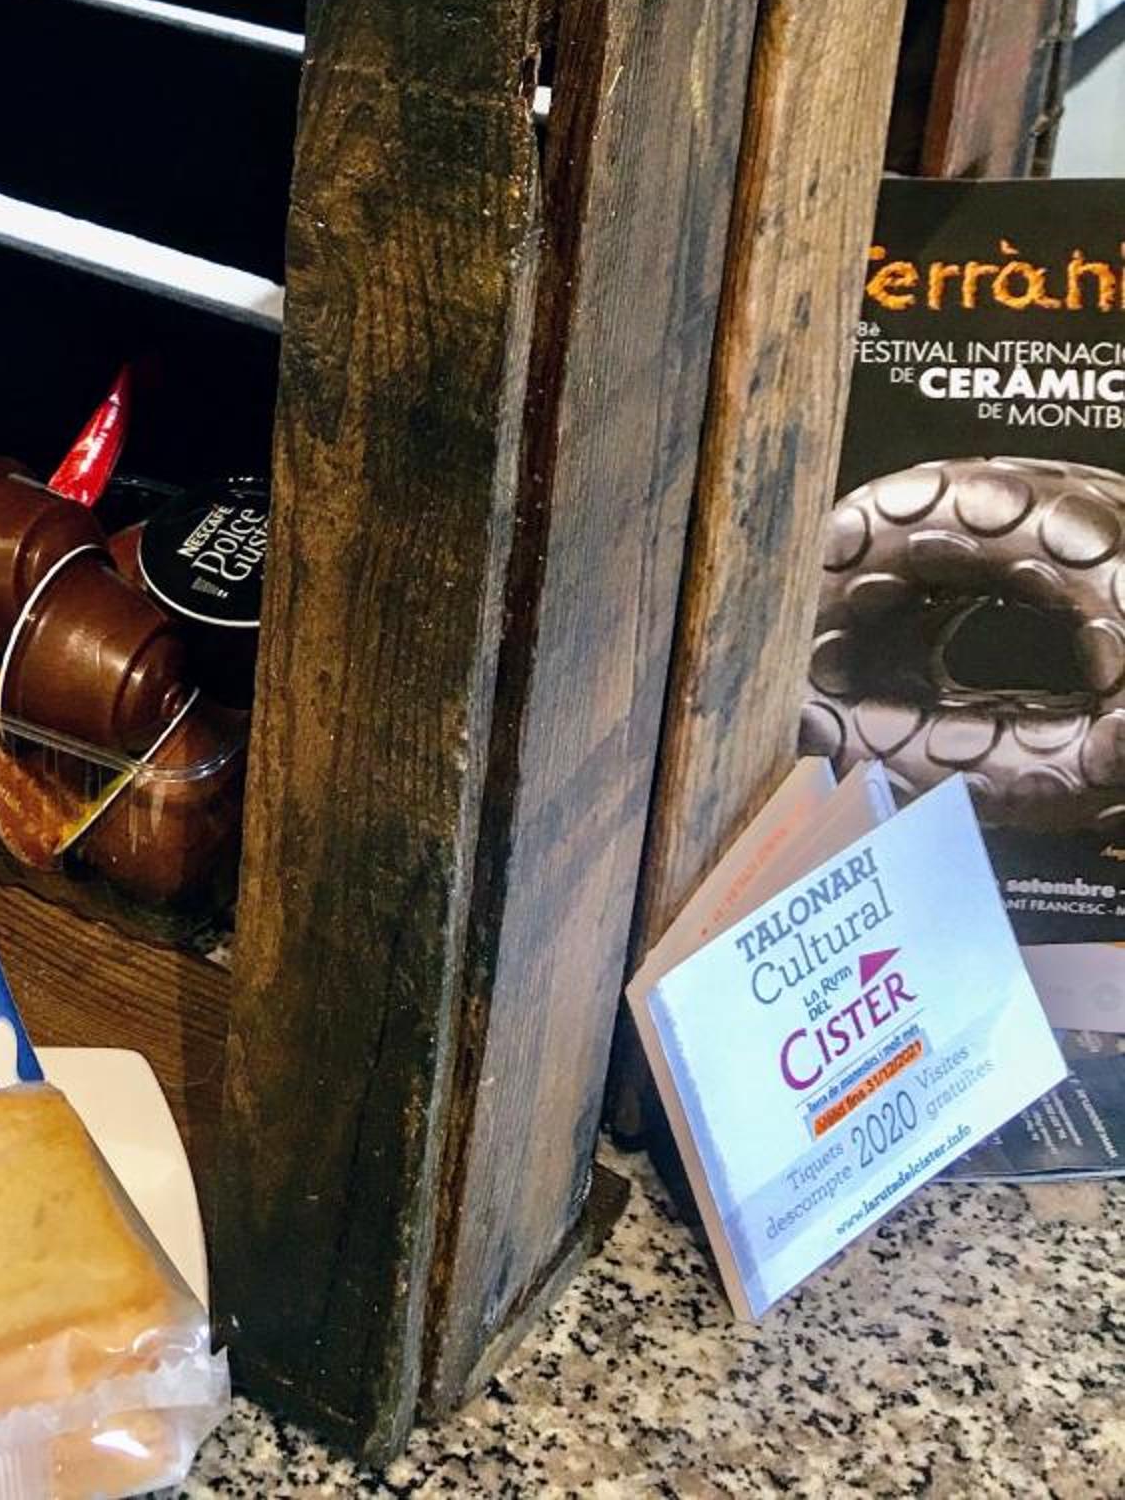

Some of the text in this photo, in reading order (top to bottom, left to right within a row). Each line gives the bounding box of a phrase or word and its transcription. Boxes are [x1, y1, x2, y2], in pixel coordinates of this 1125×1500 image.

[890, 367, 915, 383] DE
[968, 340, 1125, 366] INTERNACI
[978, 402, 1125, 429] DE MONTB
[191, 509, 266, 574] Dolce
[735, 846, 878, 963] TALONARI
[1005, 878, 1116, 898] setembre
[1030, 900, 1106, 916] FRANCESC
[752, 876, 894, 1005] Cultural
[780, 972, 917, 1090] CISTER
[808, 1001, 832, 1022] DEL
[786, 1047, 970, 1192] Tiquets 2020 Visites
[766, 1164, 853, 1240] descompte
